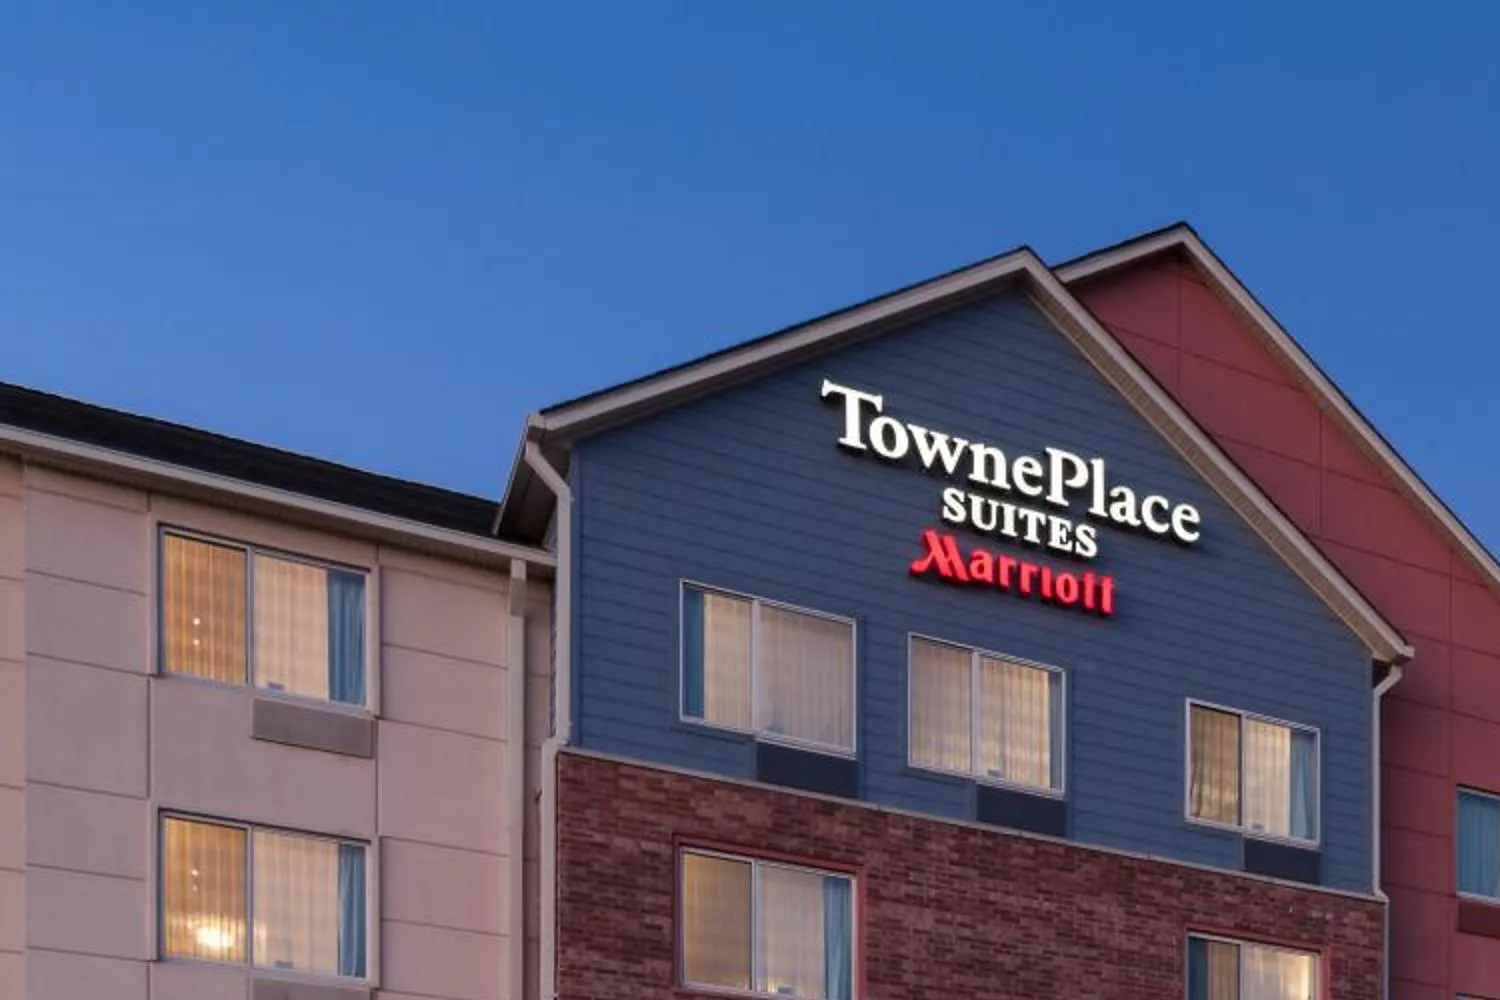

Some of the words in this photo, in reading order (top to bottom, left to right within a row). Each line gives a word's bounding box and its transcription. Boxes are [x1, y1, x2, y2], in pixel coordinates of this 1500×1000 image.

[821, 378, 1201, 543] TownePlace
[942, 486, 1098, 559] SUITES
[910, 528, 1115, 614] Marriott
